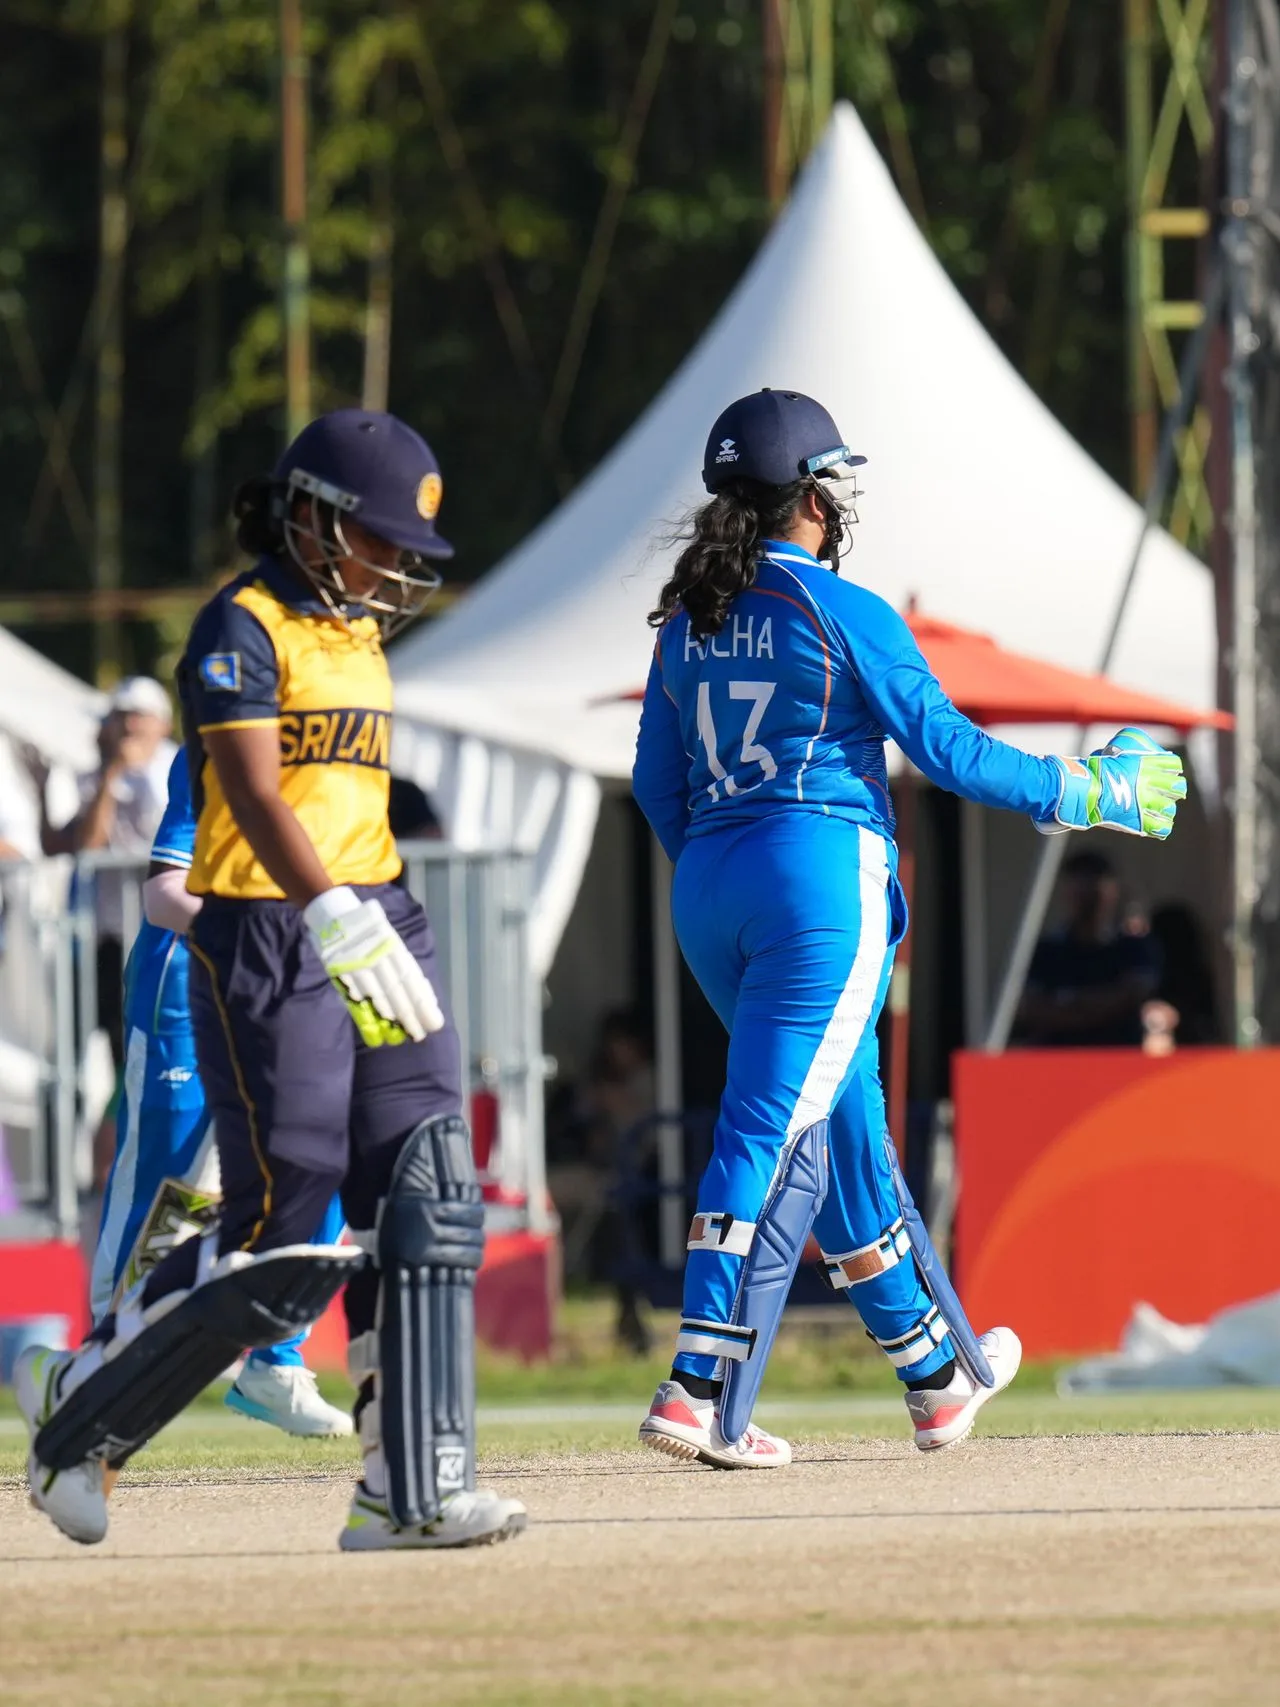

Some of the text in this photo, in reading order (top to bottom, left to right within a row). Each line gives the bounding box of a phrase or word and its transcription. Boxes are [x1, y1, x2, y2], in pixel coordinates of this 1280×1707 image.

[715, 453, 740, 464] SHREY
[279, 712, 340, 764] SRI
[696, 680, 779, 804] 13
